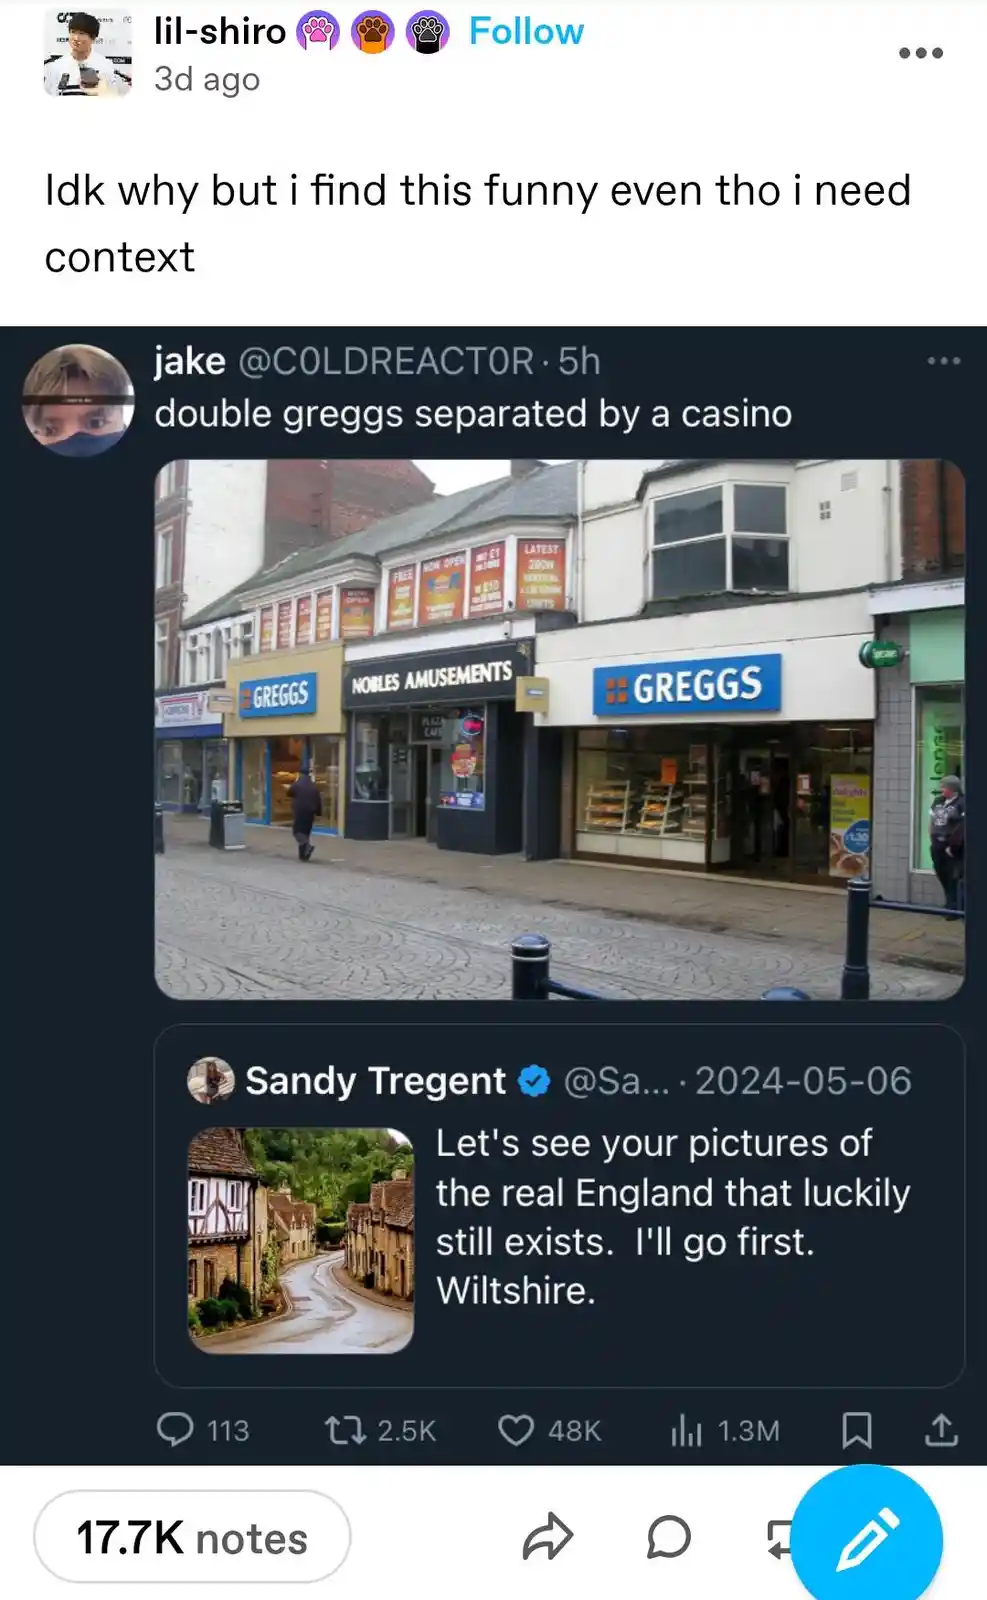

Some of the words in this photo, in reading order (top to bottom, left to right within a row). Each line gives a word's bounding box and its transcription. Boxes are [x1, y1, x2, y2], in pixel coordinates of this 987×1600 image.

[524, 544, 560, 554] LATEST
[351, 673, 401, 695] NOBLES
[404, 660, 513, 691] AMUSEMENTS
[633, 664, 763, 706] GREGGS
[253, 681, 309, 709] GREGGS
